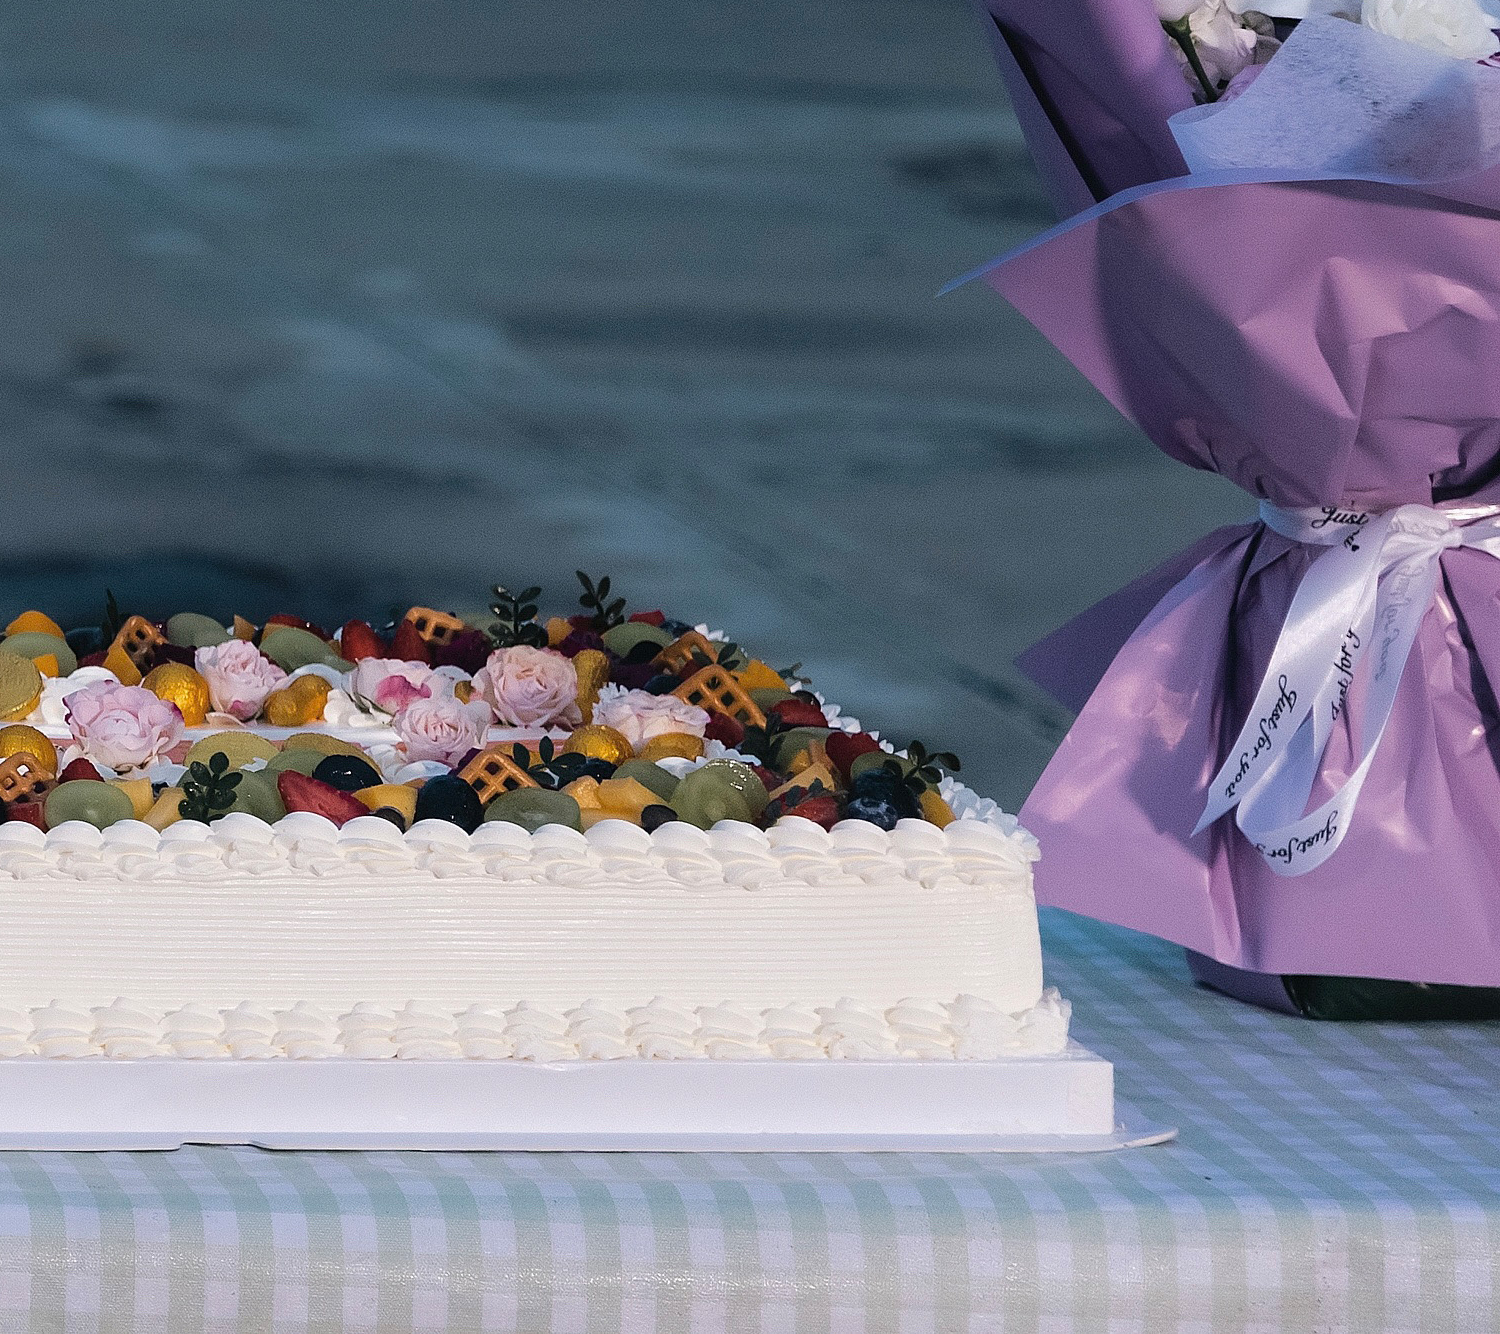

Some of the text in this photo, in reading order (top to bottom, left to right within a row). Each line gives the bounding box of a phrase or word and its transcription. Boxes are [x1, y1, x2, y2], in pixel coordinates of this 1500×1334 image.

[1311, 506, 1369, 529] Just
[1334, 641, 1354, 685] for
[1225, 674, 1297, 798] Just for you
[1267, 810, 1338, 864] Just for
